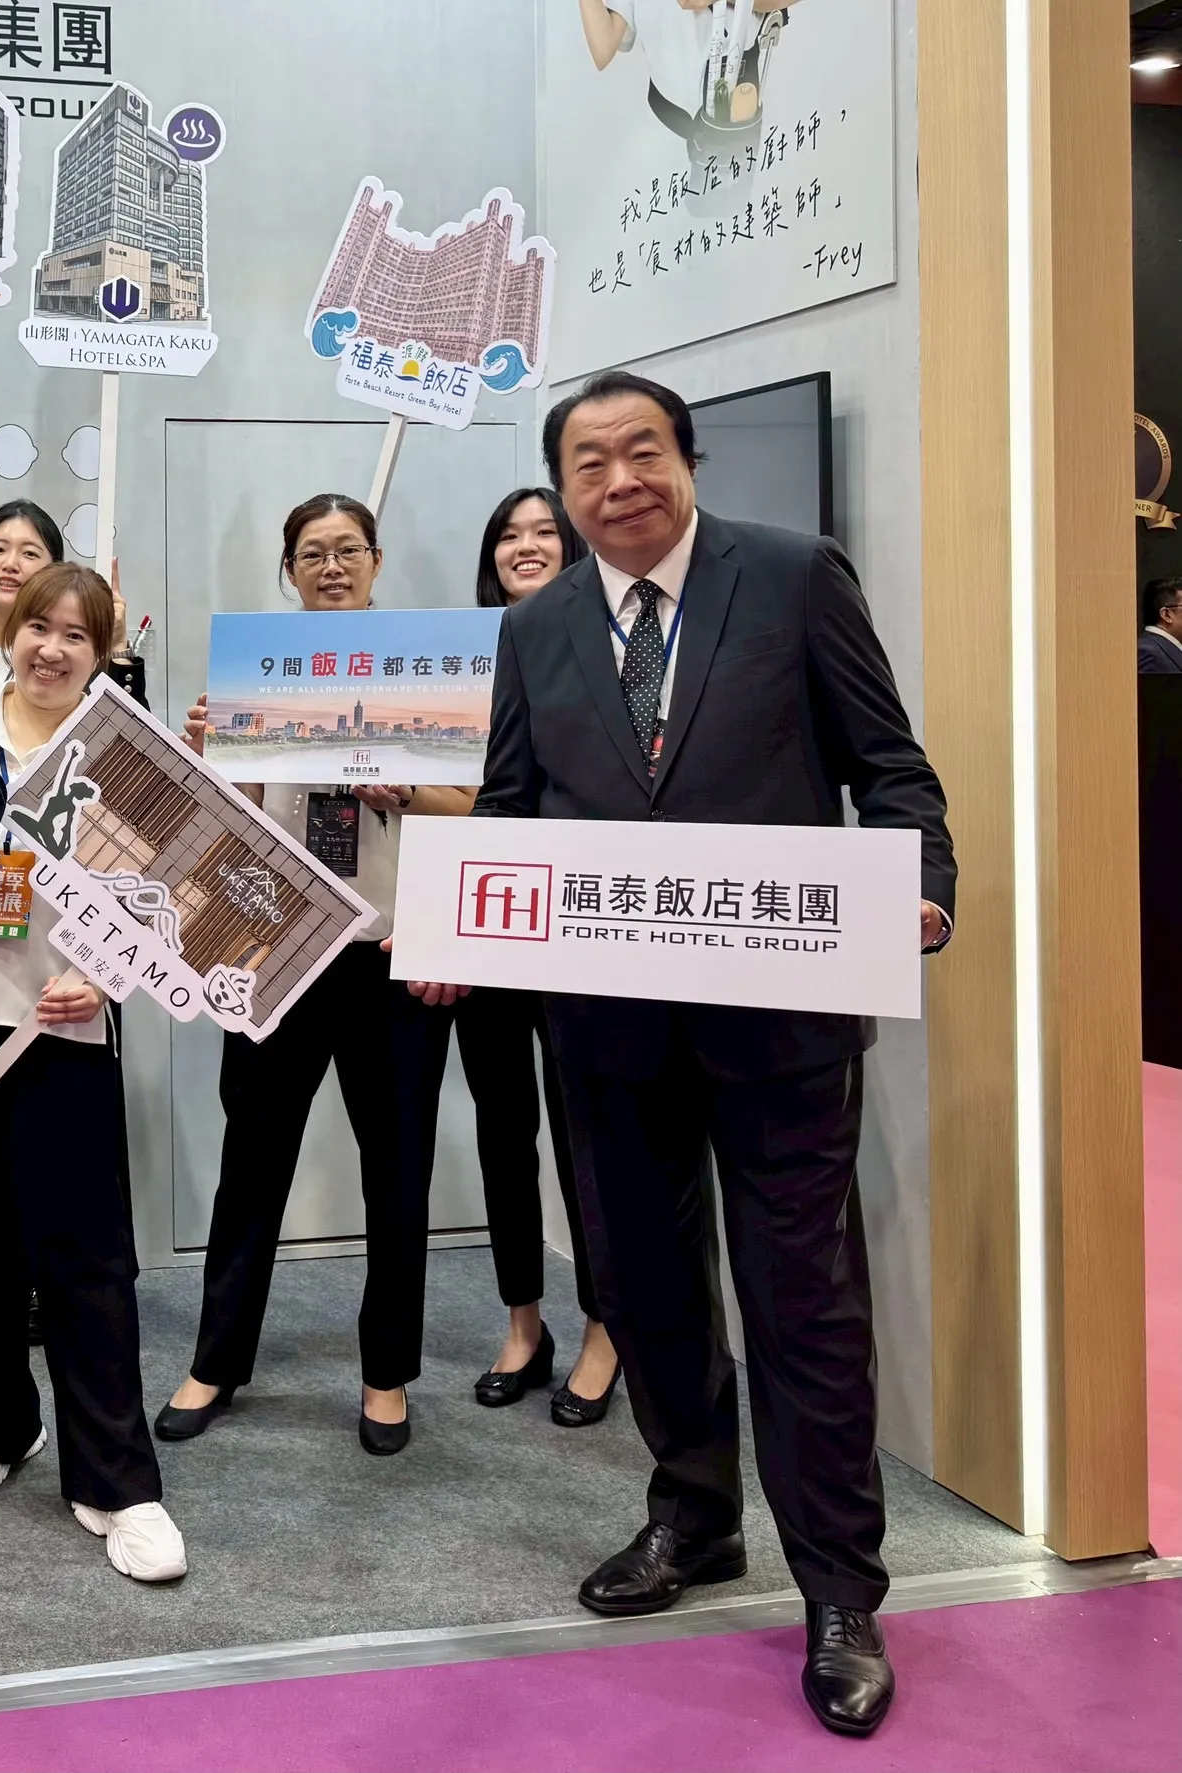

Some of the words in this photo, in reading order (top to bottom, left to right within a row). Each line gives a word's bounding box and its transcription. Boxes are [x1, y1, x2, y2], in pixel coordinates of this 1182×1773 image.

[5, 95, 98, 120] ROU
[81, 328, 166, 348] YAMAGATA
[169, 335, 212, 351] KAKU
[350, 341, 395, 378] 福泰
[422, 362, 473, 397] 飯店
[344, 374, 361, 387] Forte
[363, 379, 382, 393] Beach
[384, 386, 405, 400] Resort
[407, 393, 426, 405] Green
[429, 399, 440, 412] Bay
[442, 403, 463, 416] Hotel
[1134, 414, 1150, 429] OTEL
[1151, 427, 1170, 459] AWARDS
[260, 651, 492, 678] 9間飯店都在等你
[319, 685, 362, 693] LOOKING
[366, 685, 412, 693] FORWARD
[219, 863, 284, 923] UKETAMO
[224, 889, 255, 920] HOTEL
[562, 873, 838, 926] 福泰飯店集團
[35, 864, 190, 1008] UKETAMO
[562, 926, 640, 942] FORTE
[650, 930, 735, 948] HOTEL
[744, 936, 838, 953] GROUP
